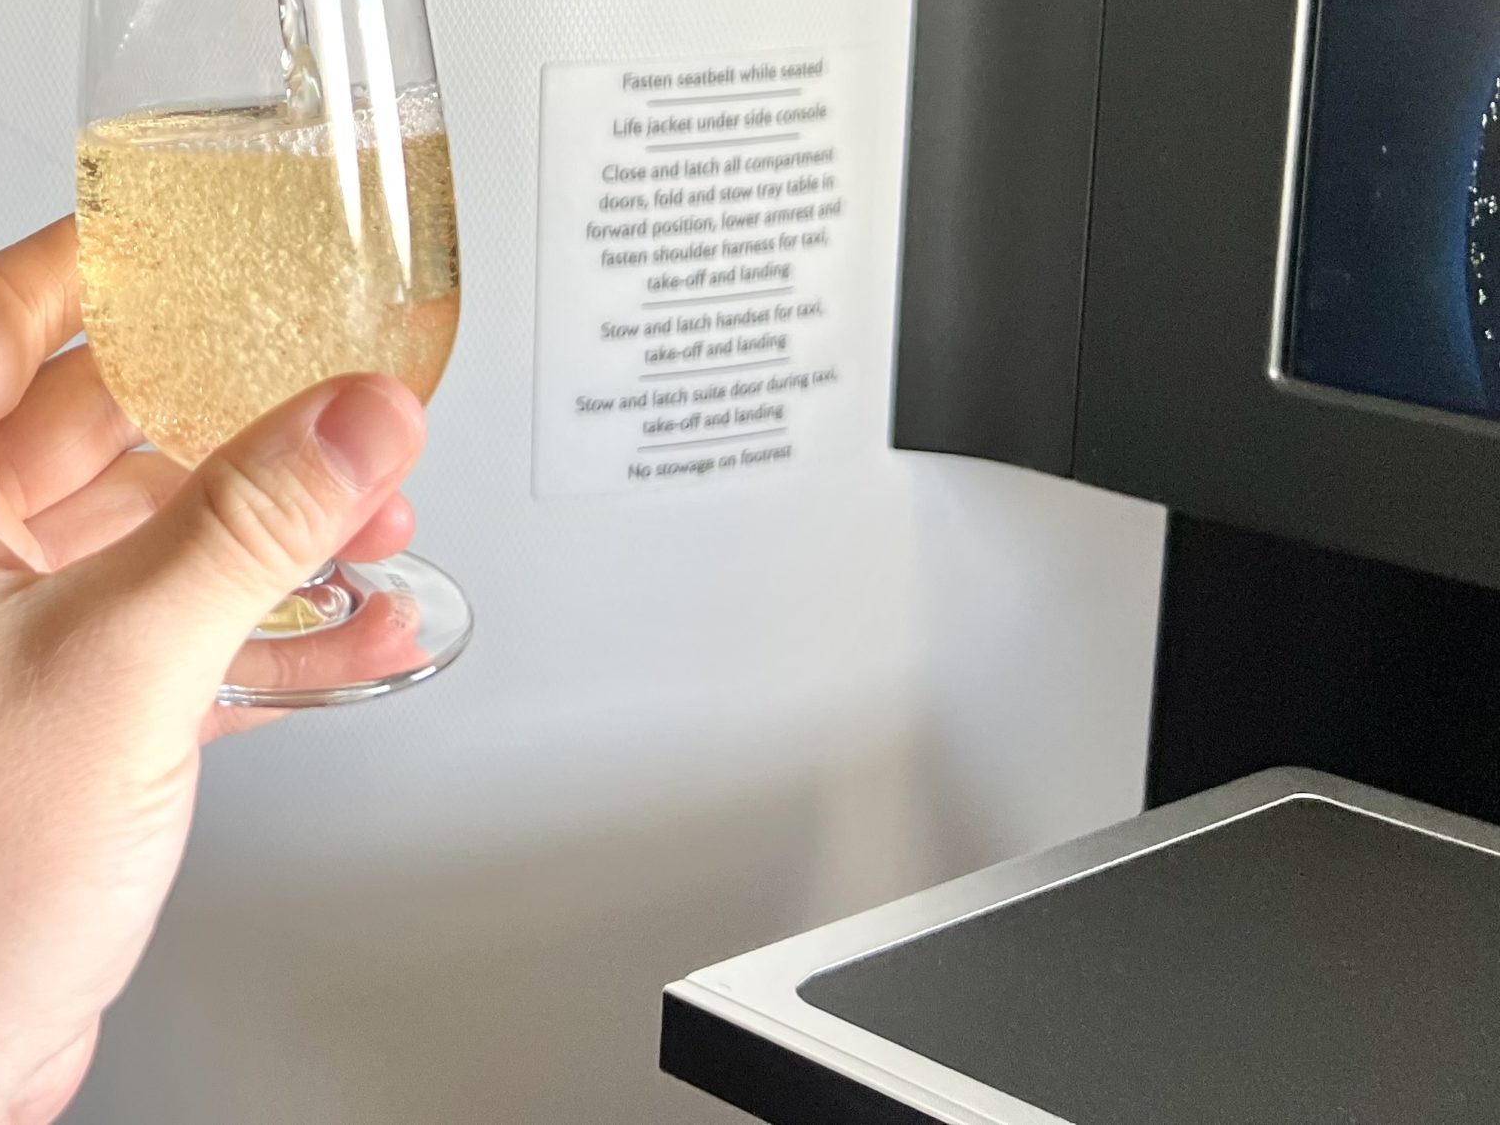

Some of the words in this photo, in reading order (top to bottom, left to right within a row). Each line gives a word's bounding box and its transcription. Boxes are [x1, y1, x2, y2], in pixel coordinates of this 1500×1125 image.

[622, 72, 672, 91] Fasten
[676, 66, 735, 88] seatbelt
[739, 62, 776, 83] while
[781, 59, 823, 78] seated
[613, 119, 642, 137] Life
[645, 116, 692, 139] jacket
[697, 111, 739, 131] under
[743, 106, 772, 126] side
[775, 101, 827, 123] console
[601, 162, 646, 183] Close
[651, 158, 680, 179] and
[684, 153, 720, 176] latch
[723, 151, 741, 173] all
[744, 146, 834, 172] compartment
[599, 191, 648, 212] doors,
[653, 188, 683, 209] fold
[687, 184, 715, 205] and
[719, 183, 753, 201] stow
[756, 178, 783, 201] tray
[786, 173, 819, 193] table
[821, 171, 834, 189] in
[585, 218, 647, 241] forward
[651, 214, 717, 240] position,
[721, 210, 760, 228] lower
[764, 205, 814, 225] armrest
[817, 199, 841, 218] and
[601, 248, 648, 269] fasten
[653, 241, 718, 263] shoulder
[722, 238, 775, 258] harness
[778, 232, 799, 250] for
[647, 269, 707, 291] take-off
[709, 268, 736, 286] and
[739, 261, 790, 284] landing
[601, 321, 639, 339] Stow
[643, 316, 673, 336] and
[676, 313, 713, 334] latch
[715, 307, 771, 328] handset
[773, 302, 795, 321] for
[644, 341, 704, 363] take-off
[706, 339, 733, 357] and
[736, 332, 787, 354] landing
[575, 395, 613, 413] Stow
[618, 392, 647, 410] and
[651, 386, 688, 406] latch
[692, 382, 727, 402] suite
[730, 378, 763, 398] door
[766, 373, 810, 396] during
[642, 412, 701, 434] take-off
[704, 411, 730, 428] and
[734, 403, 784, 426] landing
[628, 462, 651, 480] No
[655, 457, 715, 478] stowage
[718, 453, 736, 468] on
